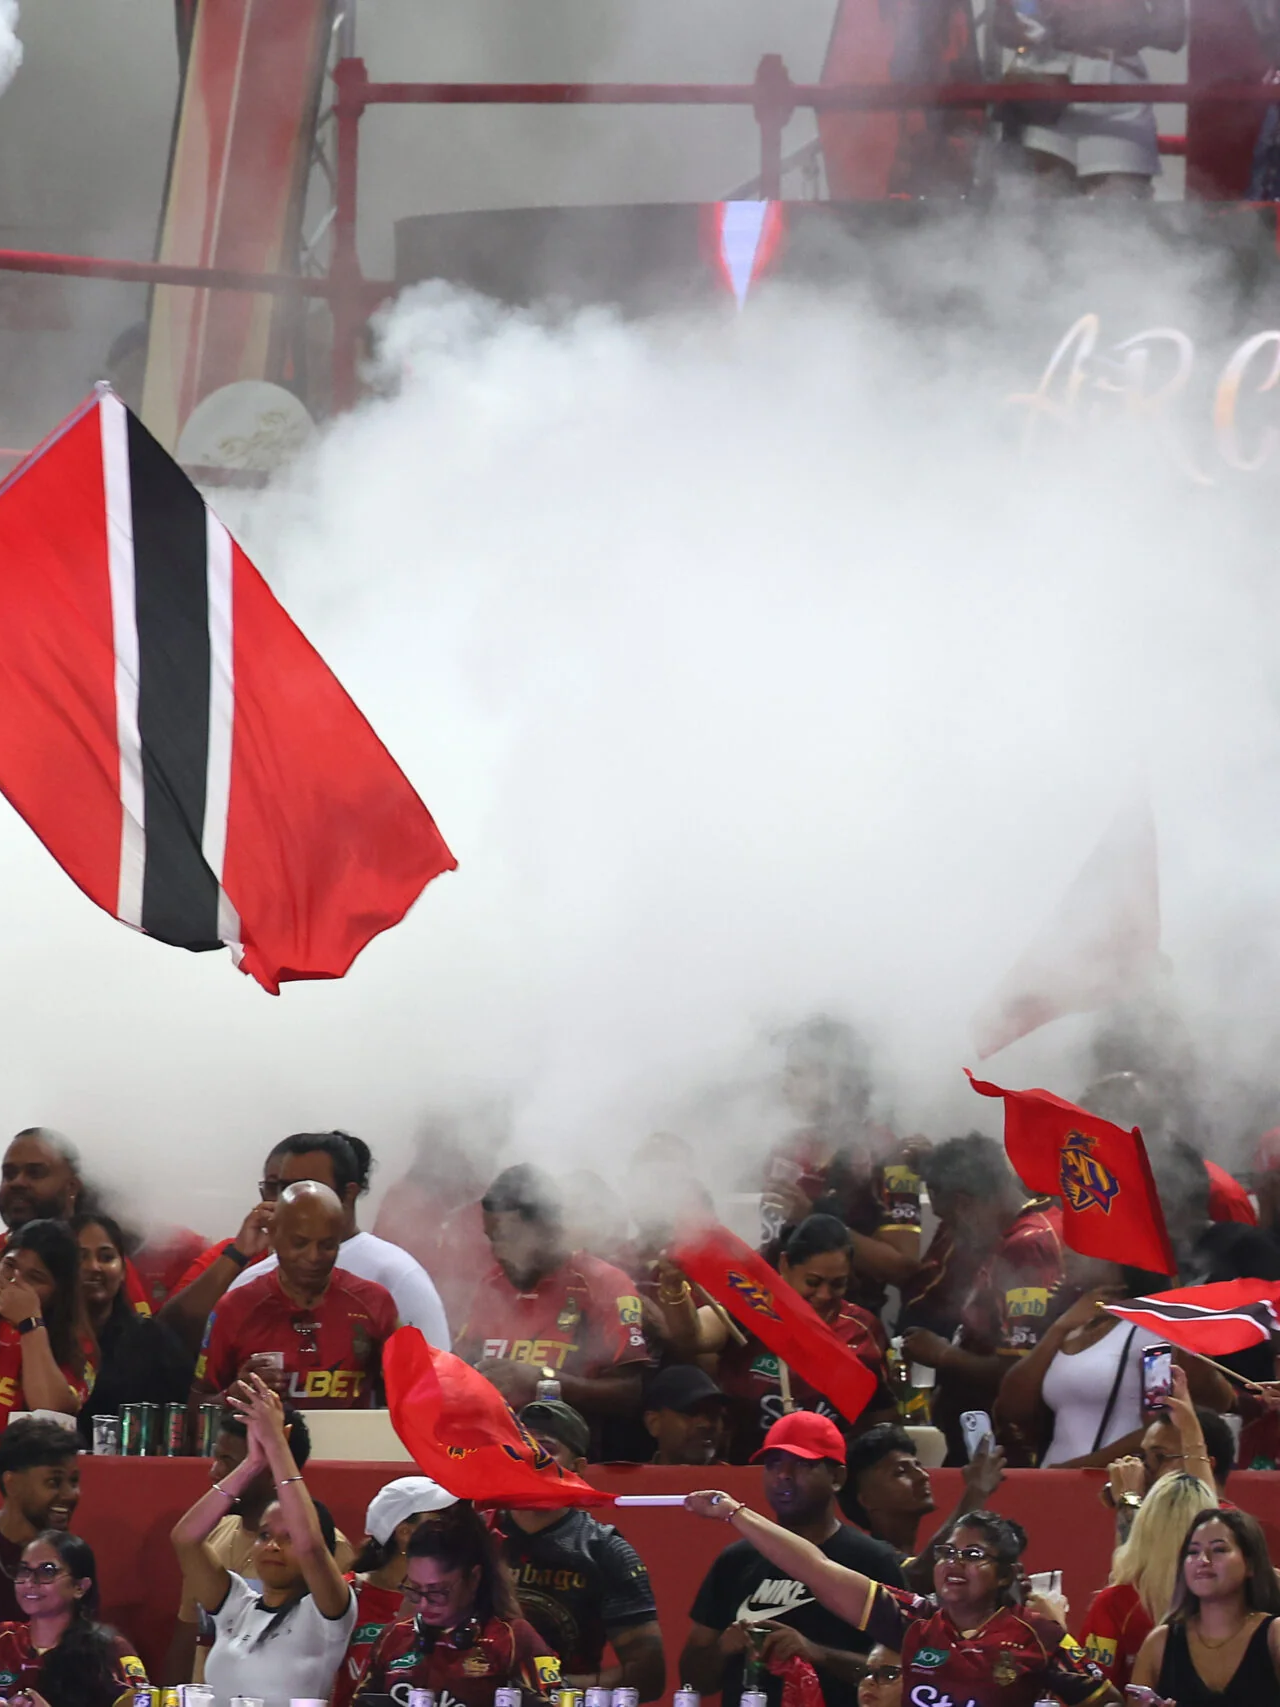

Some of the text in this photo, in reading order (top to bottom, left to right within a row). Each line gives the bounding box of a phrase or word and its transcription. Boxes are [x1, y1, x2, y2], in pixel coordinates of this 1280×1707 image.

[757, 1358, 778, 1370] JO
[750, 1578, 807, 1606] NIKE
[916, 1650, 943, 1663] JOY
